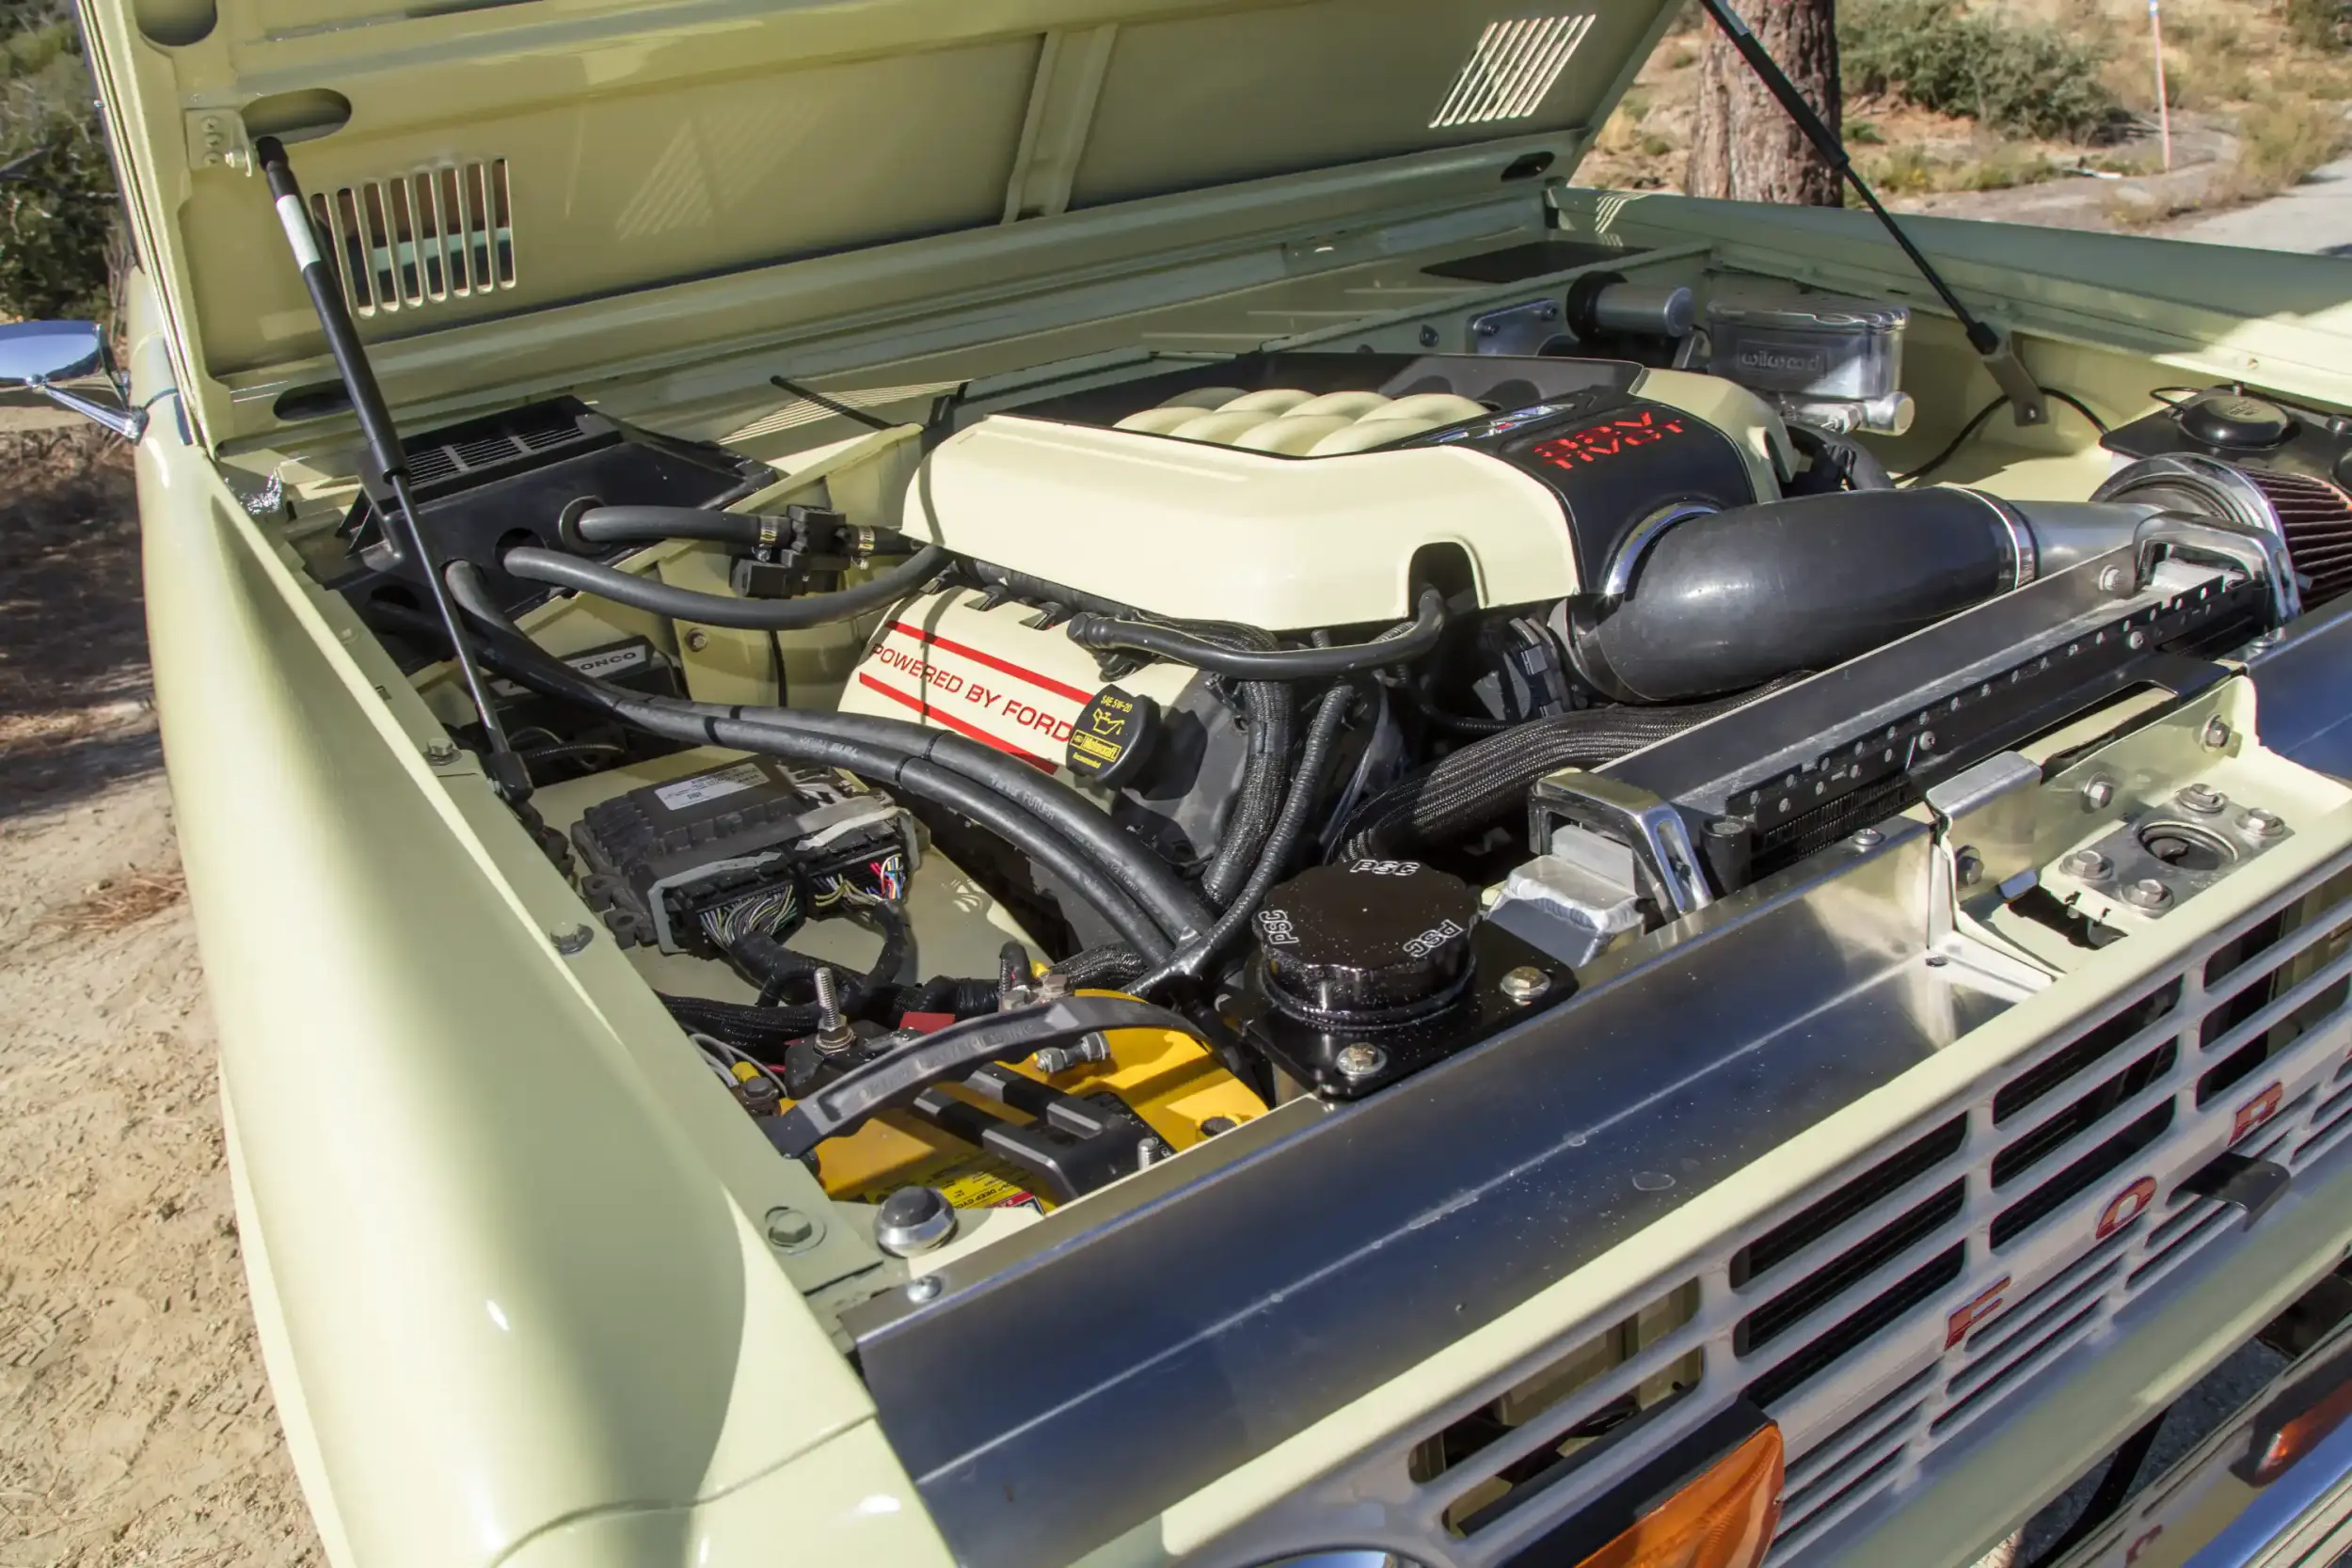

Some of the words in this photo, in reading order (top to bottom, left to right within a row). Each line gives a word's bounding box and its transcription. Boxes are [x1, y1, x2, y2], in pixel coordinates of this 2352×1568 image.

[1740, 349, 1820, 371] wilwood
[580, 652, 637, 671] ONCO
[870, 643, 963, 694] POWERED
[965, 686, 1001, 708] BY
[1002, 699, 1073, 743] FORD
[1100, 695, 1115, 707] SAE
[1349, 859, 1421, 877] PSC
[1258, 909, 1300, 945] PSC
[1403, 918, 1465, 958] PSC
